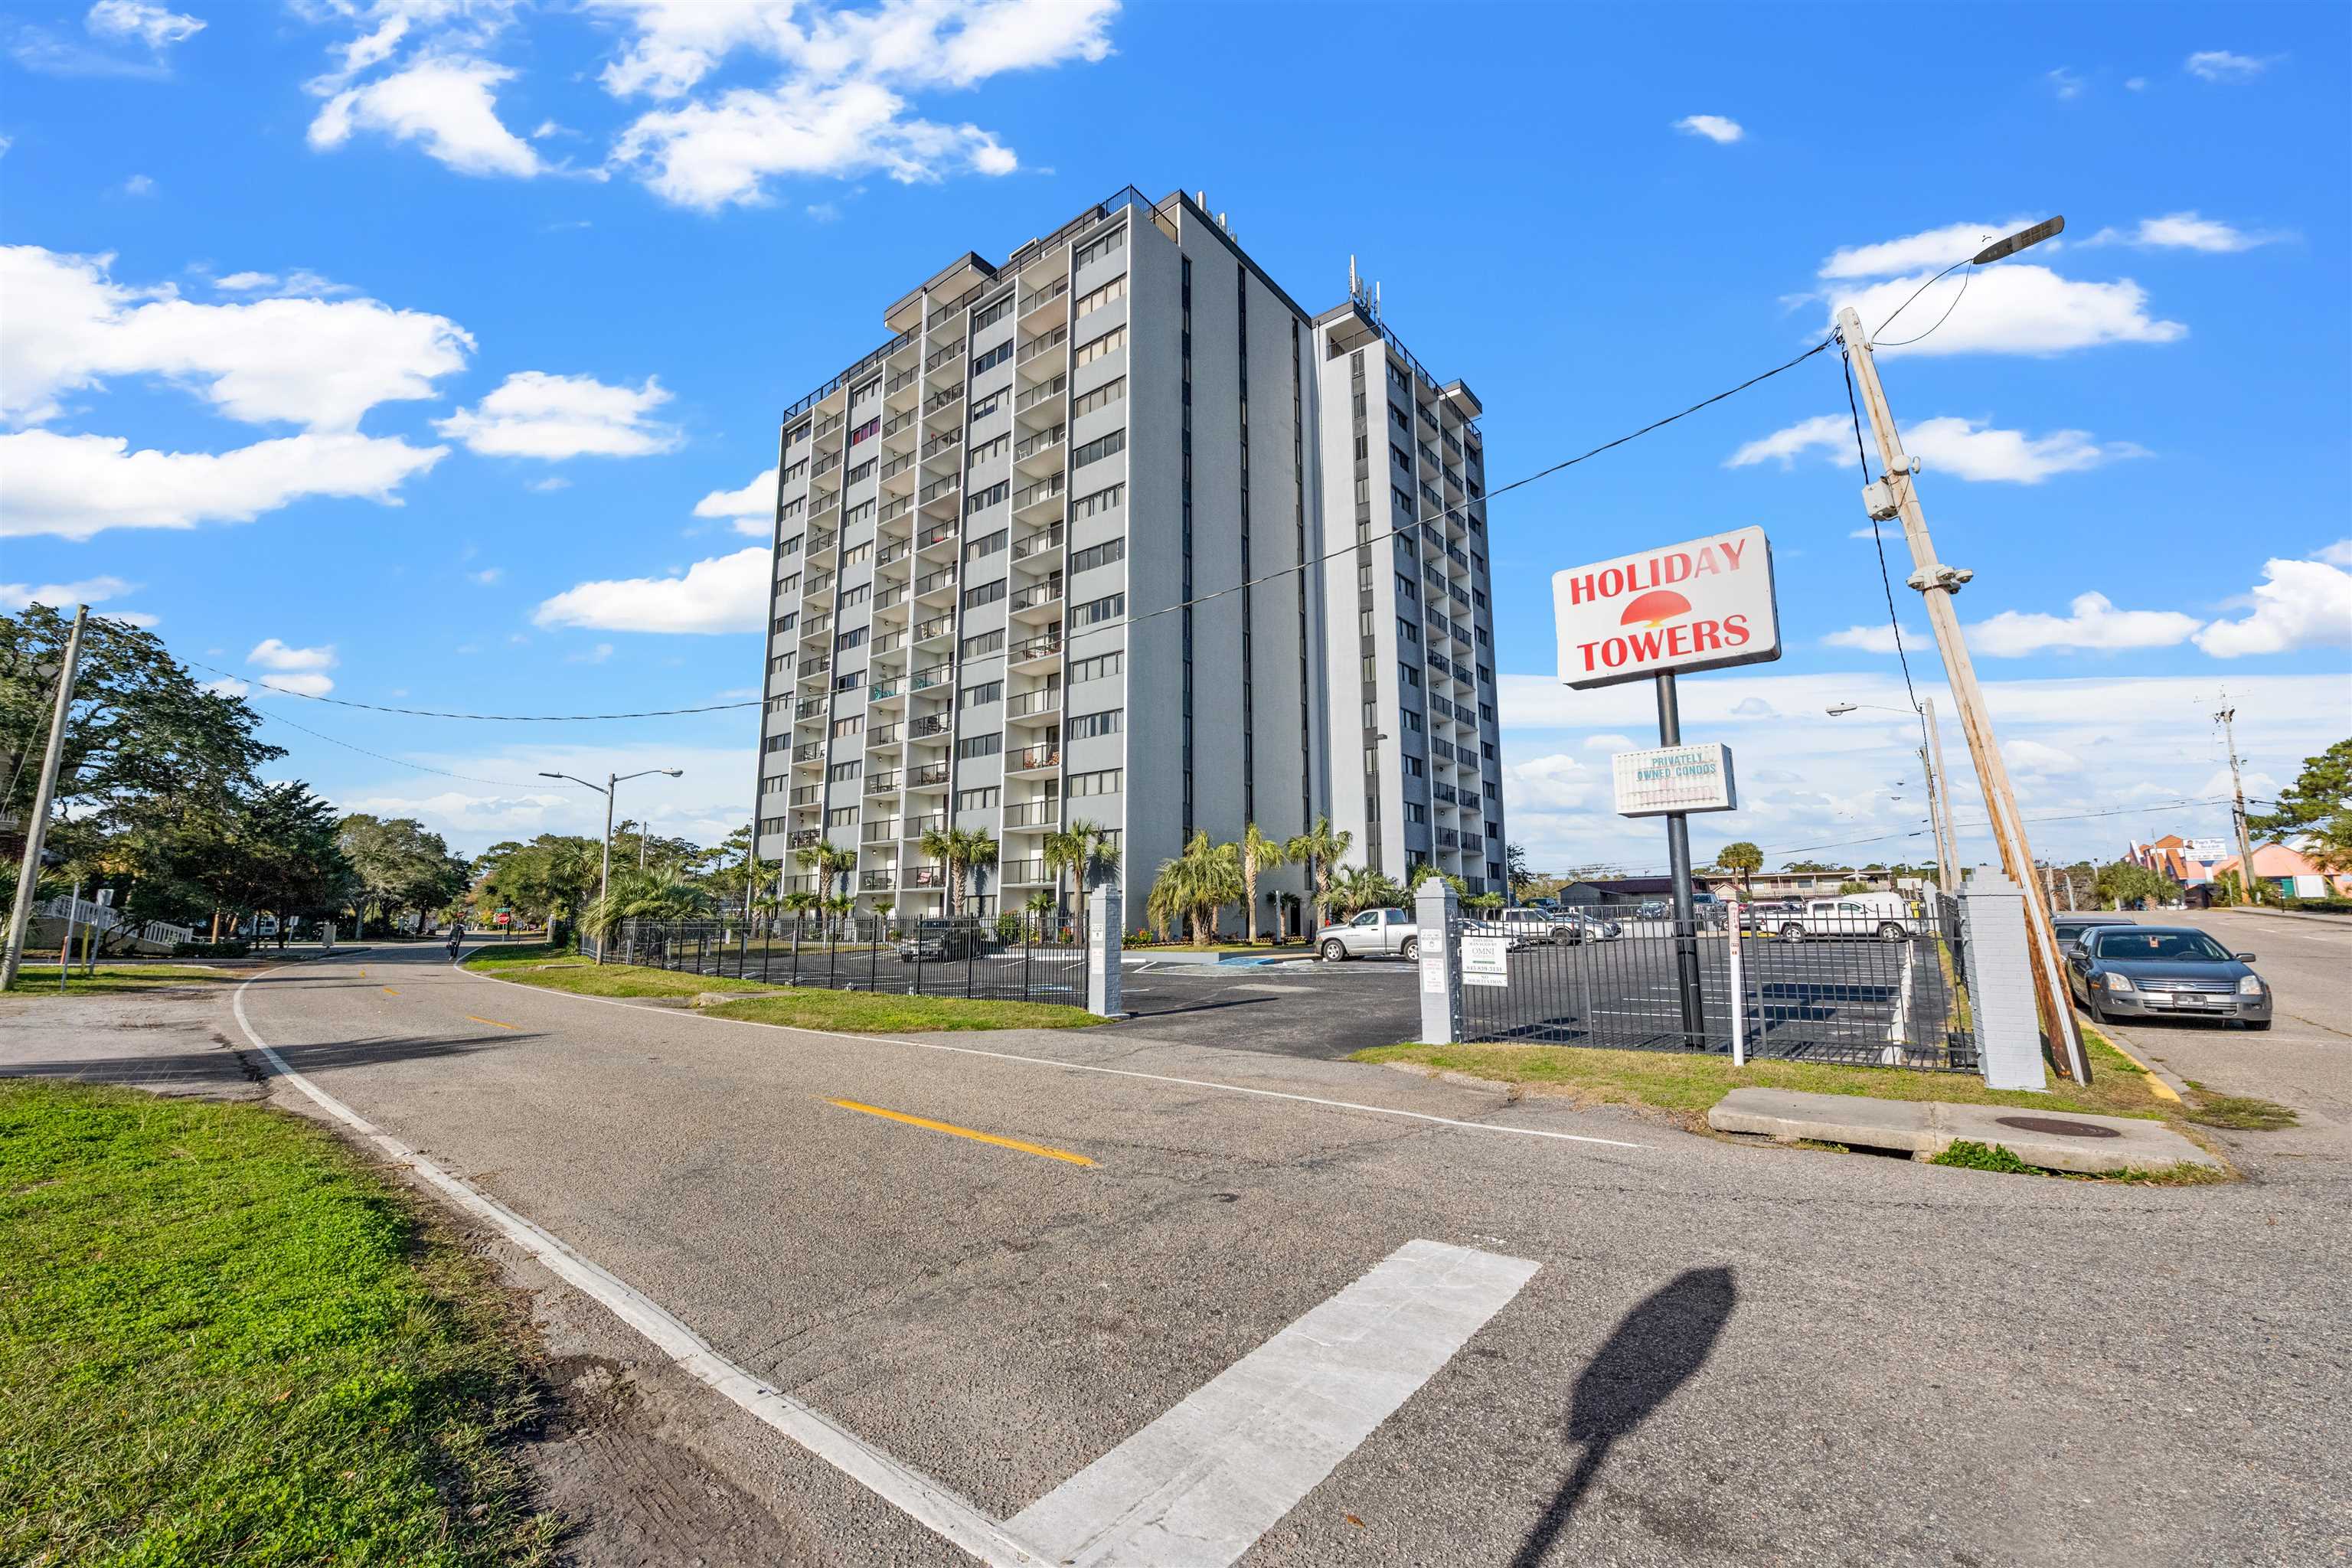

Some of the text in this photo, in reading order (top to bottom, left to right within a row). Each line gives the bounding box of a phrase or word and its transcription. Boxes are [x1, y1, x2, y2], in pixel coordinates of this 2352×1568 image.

[1570, 538, 1746, 605] HOLIDAY
[1576, 614, 1750, 671] TOWERS
[1638, 764, 1716, 780] OWNED CONDOS
[1652, 753, 1702, 766] PRIVATELY
